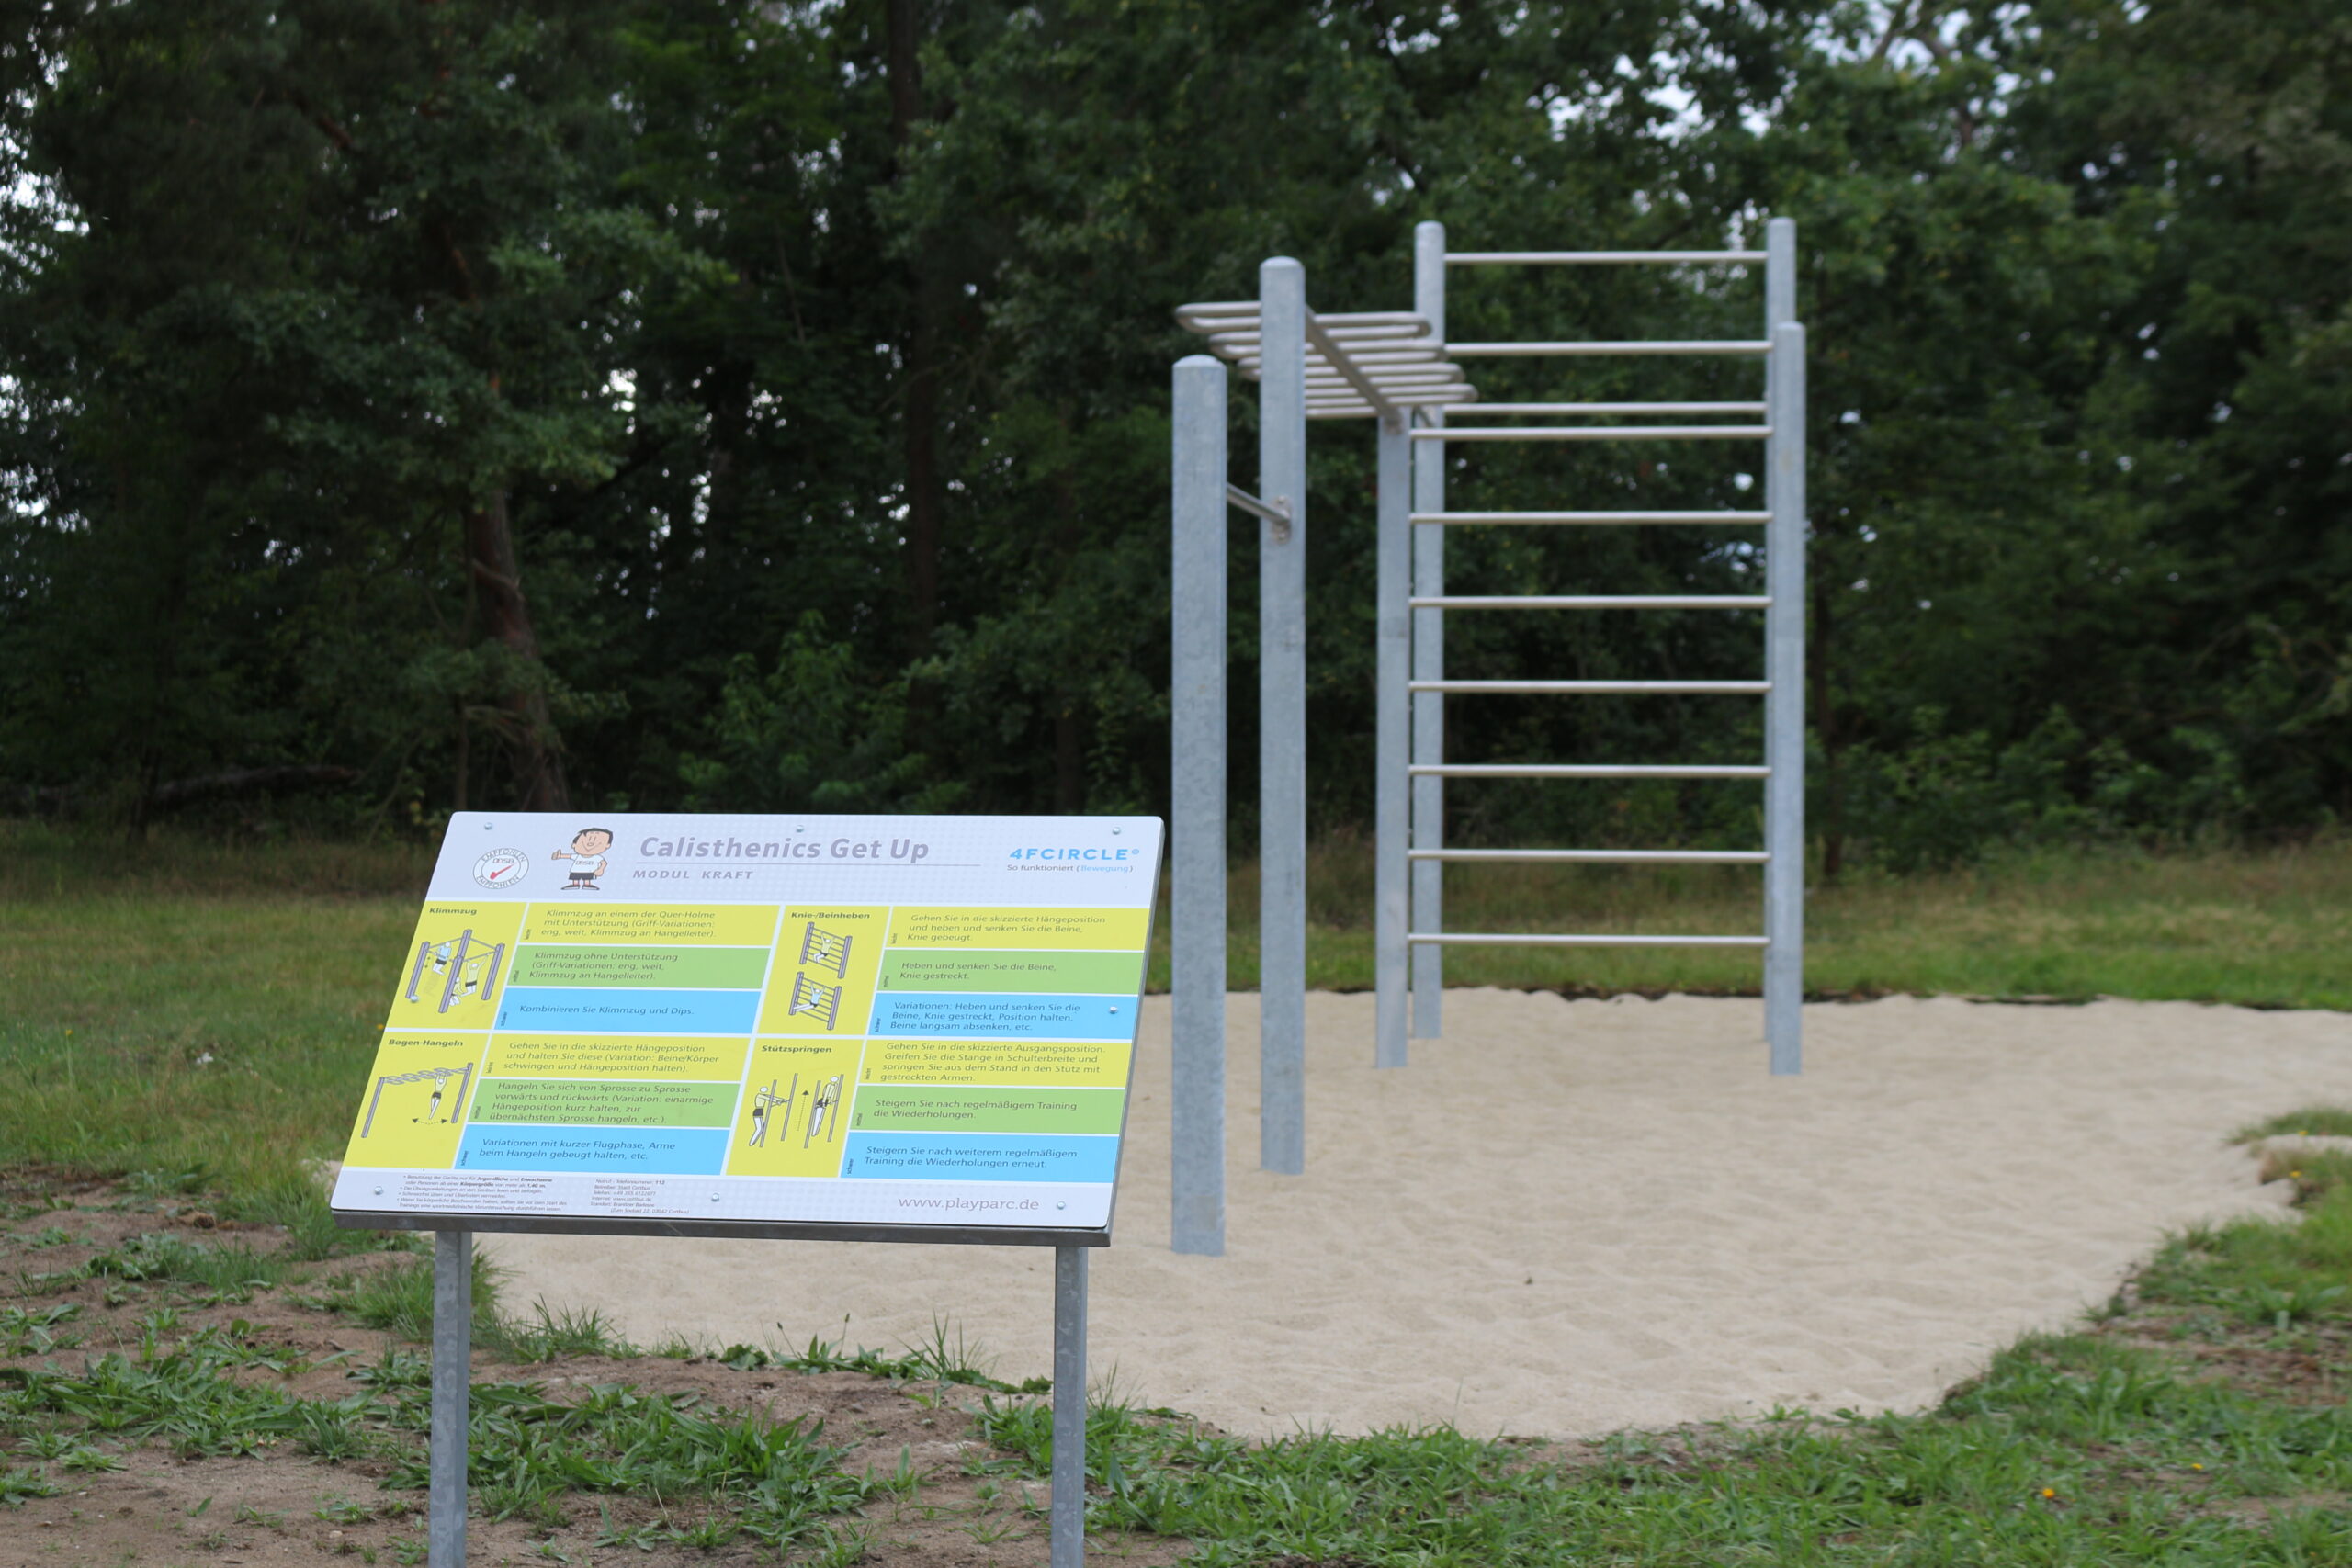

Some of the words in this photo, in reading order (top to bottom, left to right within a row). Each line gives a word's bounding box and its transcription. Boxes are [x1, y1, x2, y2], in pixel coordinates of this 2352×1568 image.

[640, 837, 821, 858] Calisthenics
[831, 838, 882, 859] Get
[890, 839, 929, 863] Up
[633, 870, 690, 879] MODUL
[702, 871, 753, 879] KRAFT
[546, 908, 593, 919] Klimmzug
[658, 910, 714, 919] Quer-Holme
[543, 918, 559, 926] mit
[561, 919, 628, 929] Unterstützung
[962, 923, 982, 931] und
[590, 928, 637, 938] Klimmzug
[534, 951, 581, 961] Klimmzug
[610, 952, 678, 962] Unterstützung
[956, 962, 989, 970] senken
[528, 970, 576, 980] Klimmzug
[519, 1004, 579, 1012] Kombinieren
[582, 1005, 595, 1013] Sie
[598, 1006, 646, 1015] Klimmzug
[649, 1006, 668, 1014] und
[1012, 1002, 1045, 1010] senken
[998, 1012, 1036, 1021] Position
[919, 1021, 960, 1032] langsam
[389, 1039, 463, 1047] Bogen-Hangeln
[937, 1043, 946, 1051] in
[762, 1045, 831, 1054] Stützspringen
[506, 1051, 526, 1059] und
[560, 1052, 575, 1060] Sie
[657, 1054, 718, 1064] Beine/Körper
[957, 1054, 991, 1063] Stange
[1006, 1054, 1075, 1062] Schulterbreite
[503, 1061, 554, 1071] schwingen
[557, 1062, 577, 1070] und
[579, 1063, 649, 1073] Hängeposition
[879, 1073, 936, 1083] gestreckten
[497, 1082, 537, 1092] Hangeln
[599, 1084, 636, 1093] Sprosse
[652, 1085, 690, 1094] Sprosse
[494, 1092, 537, 1100] vorwärts
[560, 1093, 609, 1101] rückwärts
[664, 1095, 713, 1105] einarmige
[492, 1102, 562, 1112] Hängeposition
[876, 1099, 915, 1109] Steigern
[936, 1100, 960, 1108] nach
[963, 1100, 1034, 1111] regelmäßigem
[1037, 1101, 1076, 1111] Training
[489, 1112, 555, 1121] übernächsten
[558, 1113, 594, 1123] Sprosse
[482, 1138, 537, 1146] Variationen
[649, 1141, 674, 1149] Arme
[479, 1148, 503, 1156] beim
[505, 1149, 547, 1159] Hangeln
[549, 1150, 590, 1160] gebeugt
[866, 1146, 907, 1156] Steigern
[955, 1147, 1001, 1156] weiterem
[1004, 1148, 1077, 1159] regelmäßigem
[865, 1156, 904, 1167] Training
[925, 1157, 1008, 1168] Wiederholungen
[899, 1198, 1039, 1211] www.playparc.de
